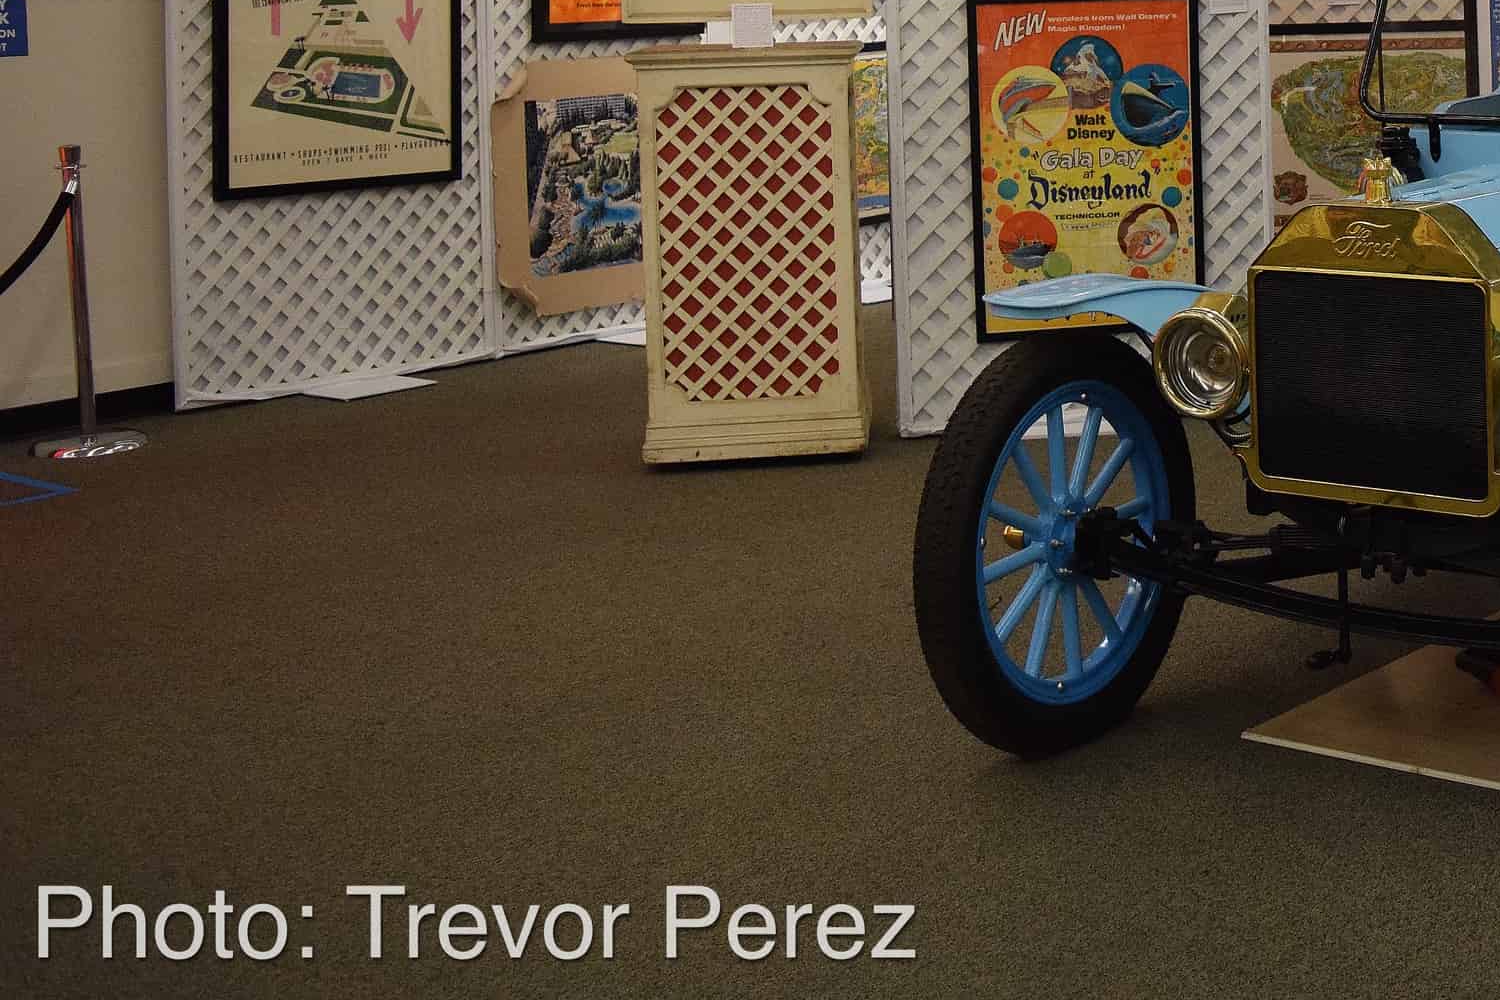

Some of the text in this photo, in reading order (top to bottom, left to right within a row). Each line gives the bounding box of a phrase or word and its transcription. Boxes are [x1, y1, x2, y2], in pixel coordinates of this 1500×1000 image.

[994, 9, 1047, 51] NEW
[1047, 14, 1090, 24] wonders
[1091, 13, 1114, 23] from
[1115, 12, 1137, 21] Walt
[1047, 22, 1126, 33] Magic Kingdom!
[1075, 113, 1107, 126] Walt
[1067, 127, 1116, 141] Disney
[234, 151, 287, 164] RESTAURANT
[1098, 146, 1144, 170] Day
[1082, 168, 1095, 179] at
[1055, 211, 1121, 221] TECHNICOLOR
[1333, 220, 1401, 258] Ford
